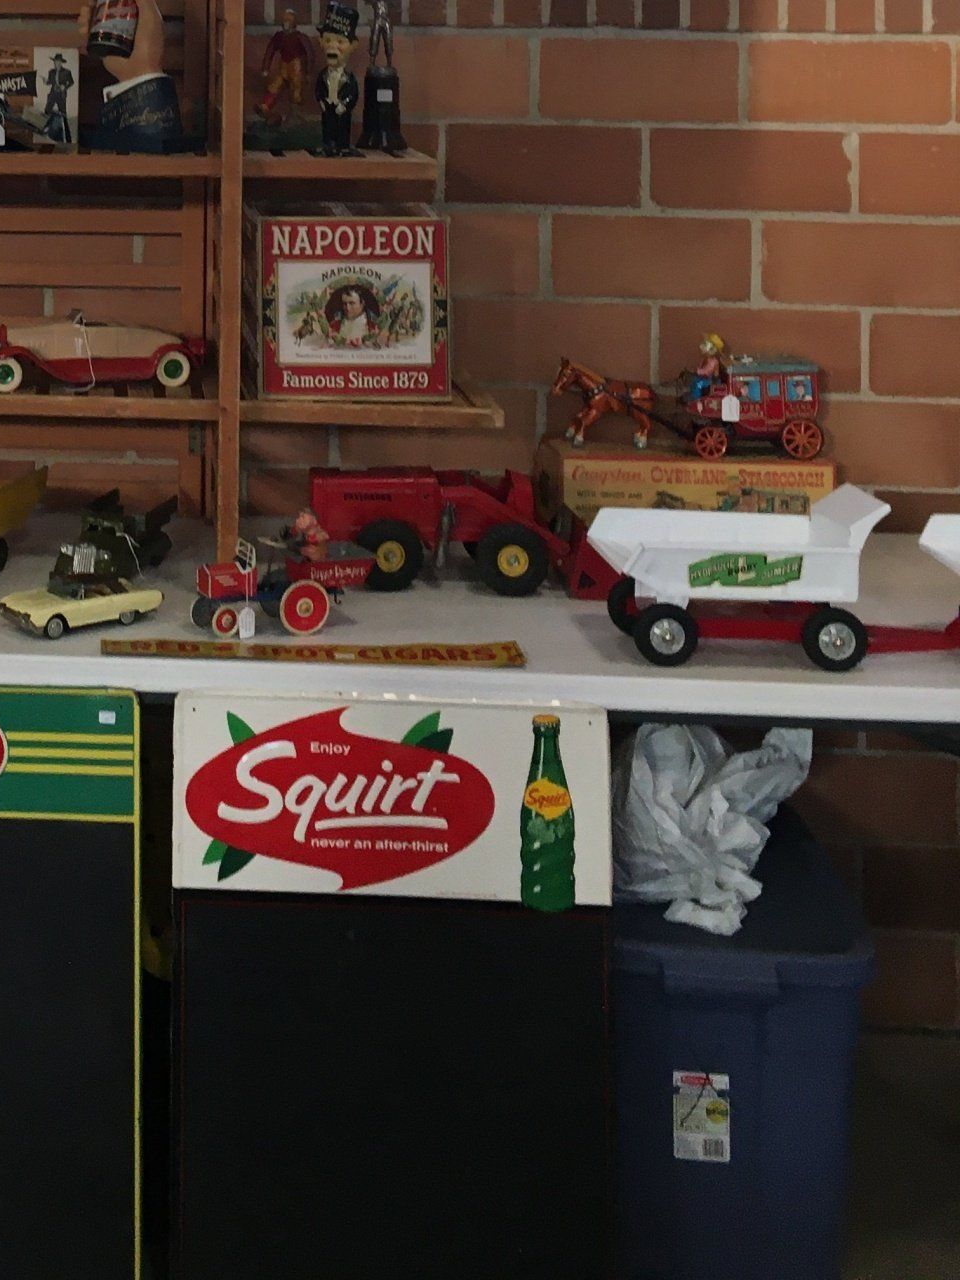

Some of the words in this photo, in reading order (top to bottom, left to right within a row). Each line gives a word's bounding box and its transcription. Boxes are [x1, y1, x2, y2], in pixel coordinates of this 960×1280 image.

[271, 225, 435, 256] NAPOLEON
[321, 266, 383, 282] NAPOLEON
[282, 370, 345, 388] Famous
[348, 371, 389, 388] Since
[393, 371, 429, 388] 1879
[356, 646, 497, 663] CIGARS
[309, 740, 351, 756] Enjoy
[217, 739, 461, 843] Squirt
[526, 786, 571, 809] Squirt
[310, 838, 350, 850] never
[353, 840, 372, 851] an
[374, 839, 450, 854] after-thirst
